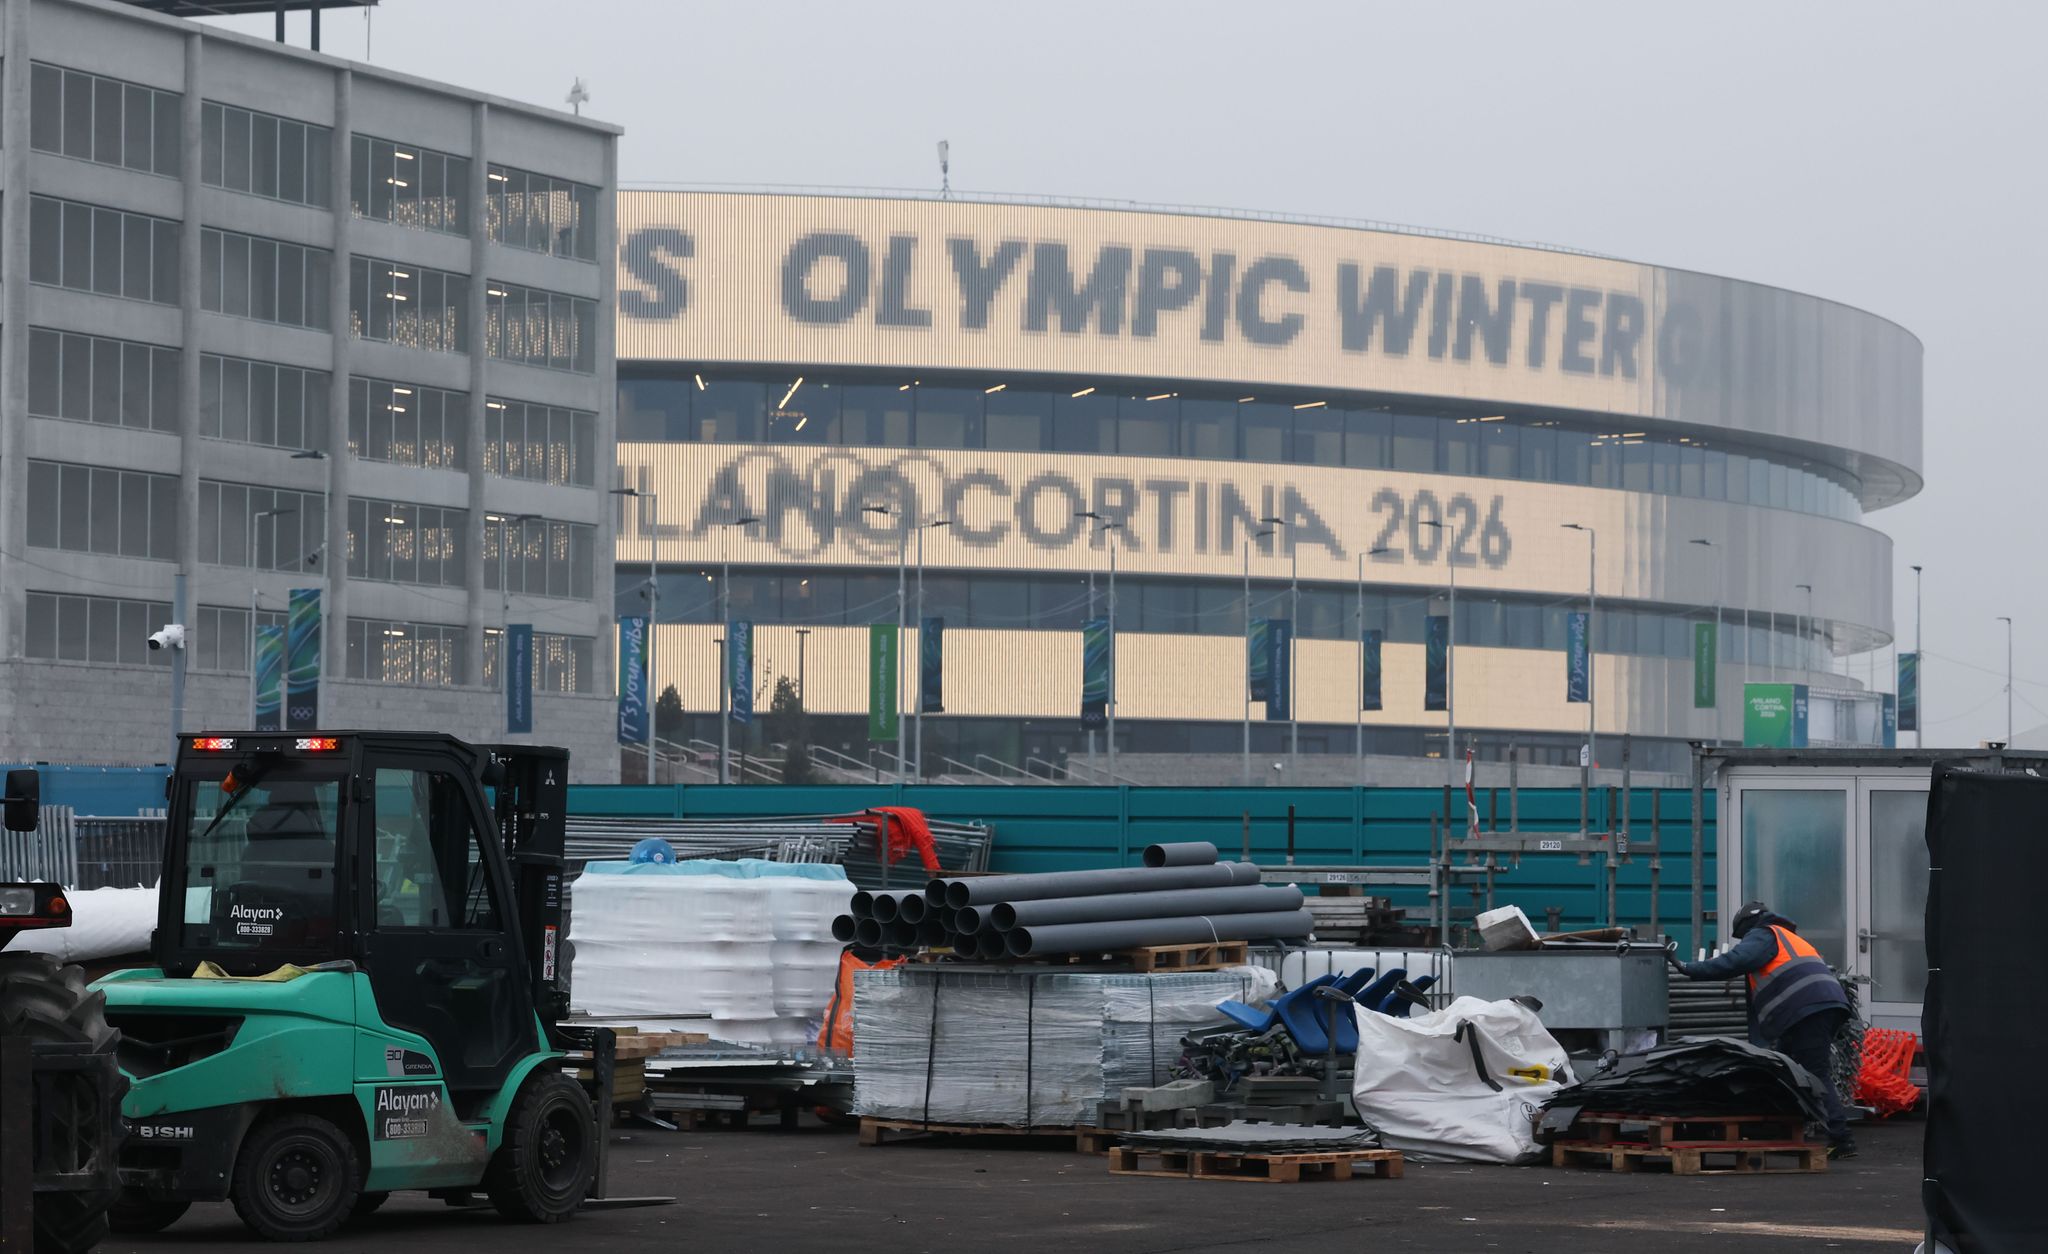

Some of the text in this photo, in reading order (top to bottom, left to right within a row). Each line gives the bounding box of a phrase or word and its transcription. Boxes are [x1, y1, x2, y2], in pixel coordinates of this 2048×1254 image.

[780, 231, 1310, 347] OLYMPIC
[1337, 258, 1645, 380] WINTER
[946, 468, 1347, 562] CORTINA
[1367, 486, 1512, 571] 2026
[625, 617, 644, 654] vibe
[732, 622, 749, 652] vibe
[625, 656, 643, 706] your
[734, 654, 749, 694] your
[1541, 840, 1561, 849] 29120
[230, 904, 274, 922] Alayan
[386, 1050, 402, 1061] 30
[377, 1088, 429, 1116] Alayan
